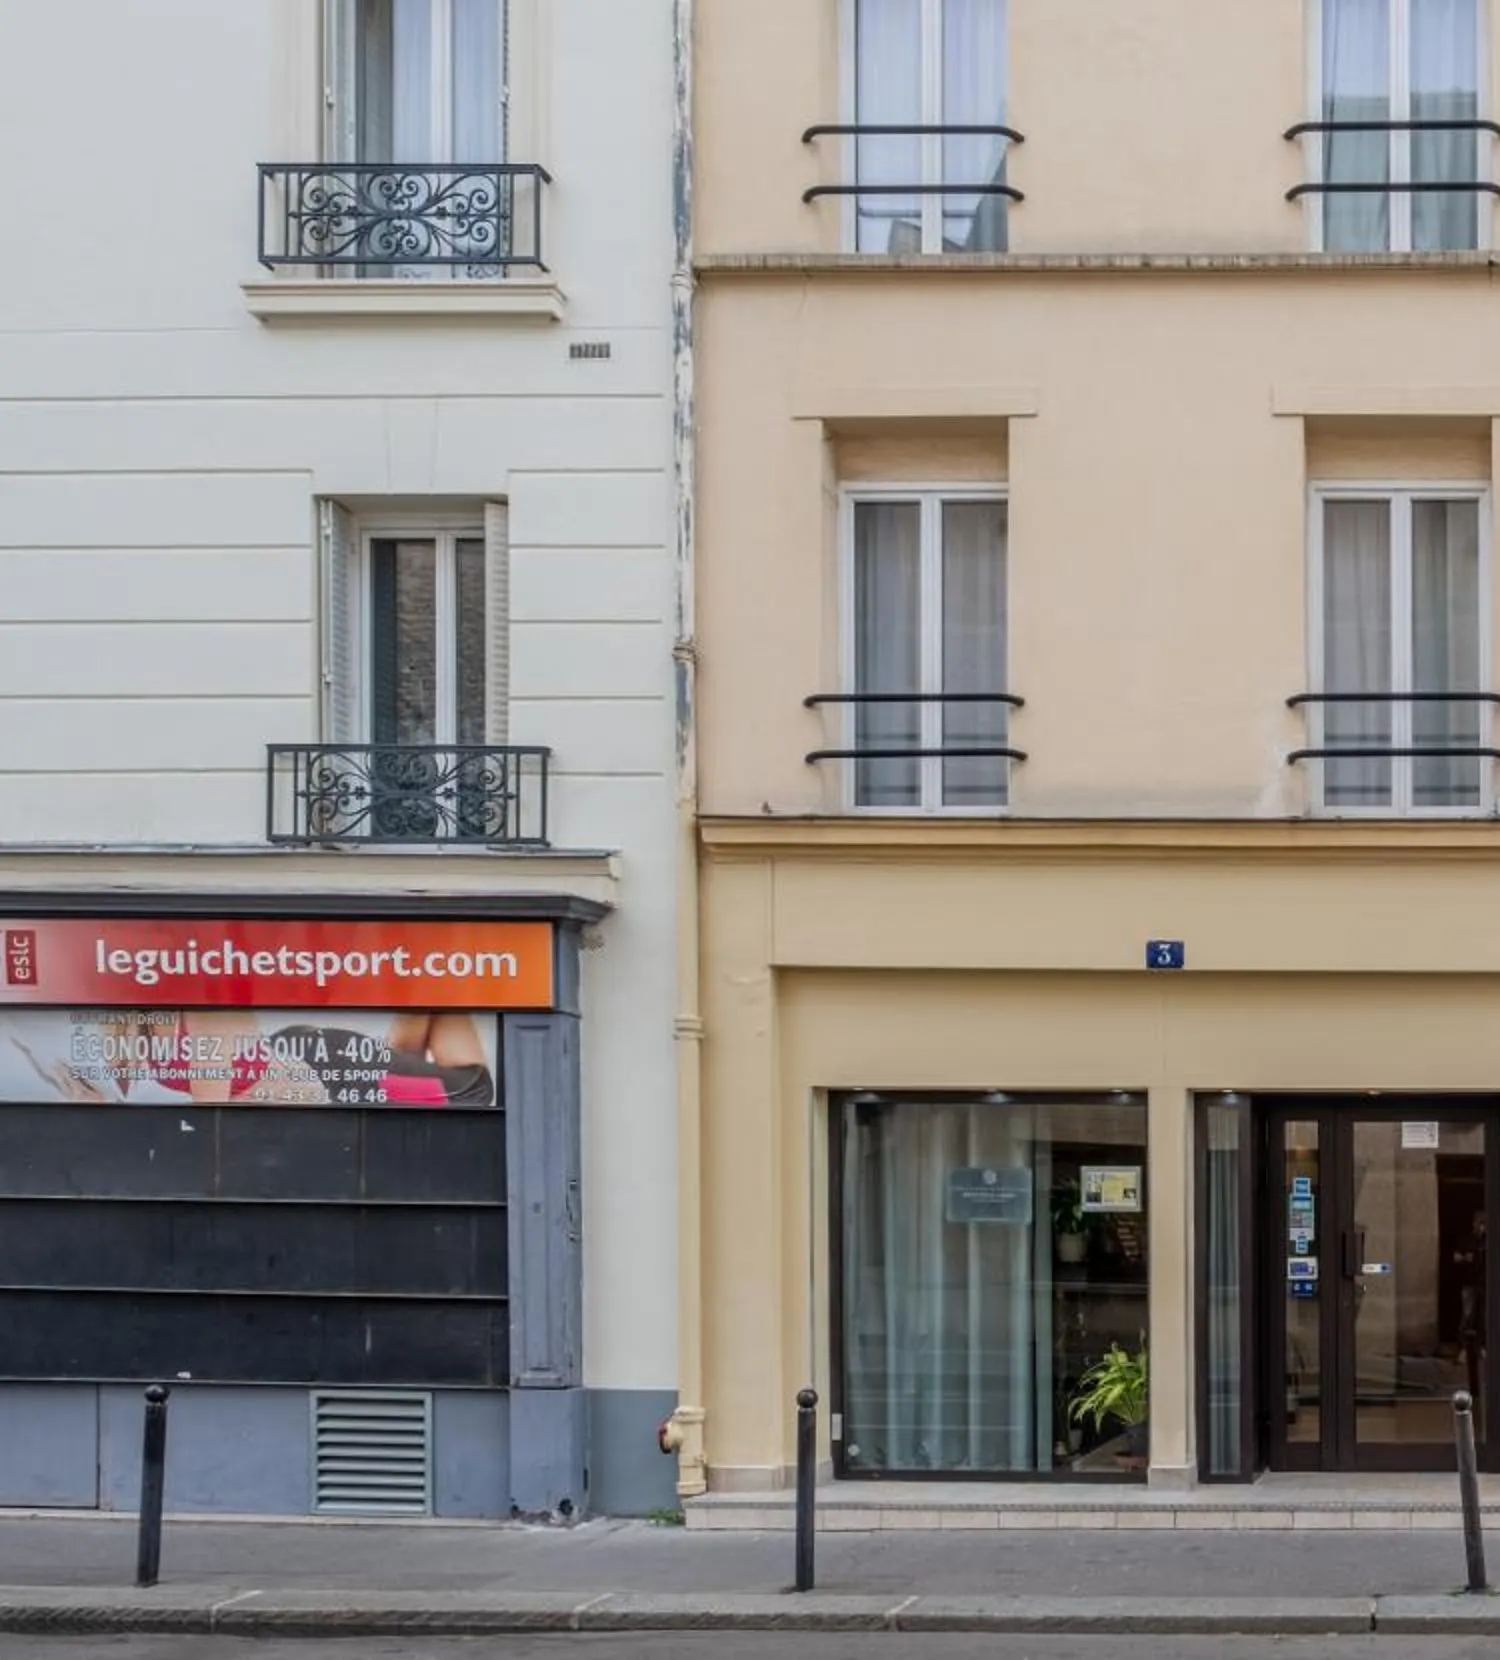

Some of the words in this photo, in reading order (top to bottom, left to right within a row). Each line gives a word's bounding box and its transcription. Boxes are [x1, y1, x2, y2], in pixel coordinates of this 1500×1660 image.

[96, 938, 518, 987] leguichetsport.com
[1157, 943, 1171, 965] 3
[71, 1026, 224, 1062] ÉCONOMISEZ
[231, 1028, 330, 1063] JUSQU'À
[337, 1035, 392, 1063] -40%
[322, 1069, 341, 1082] DE
[343, 1069, 389, 1082] SPORT
[337, 1088, 360, 1103] 46
[364, 1088, 387, 1103] 46
